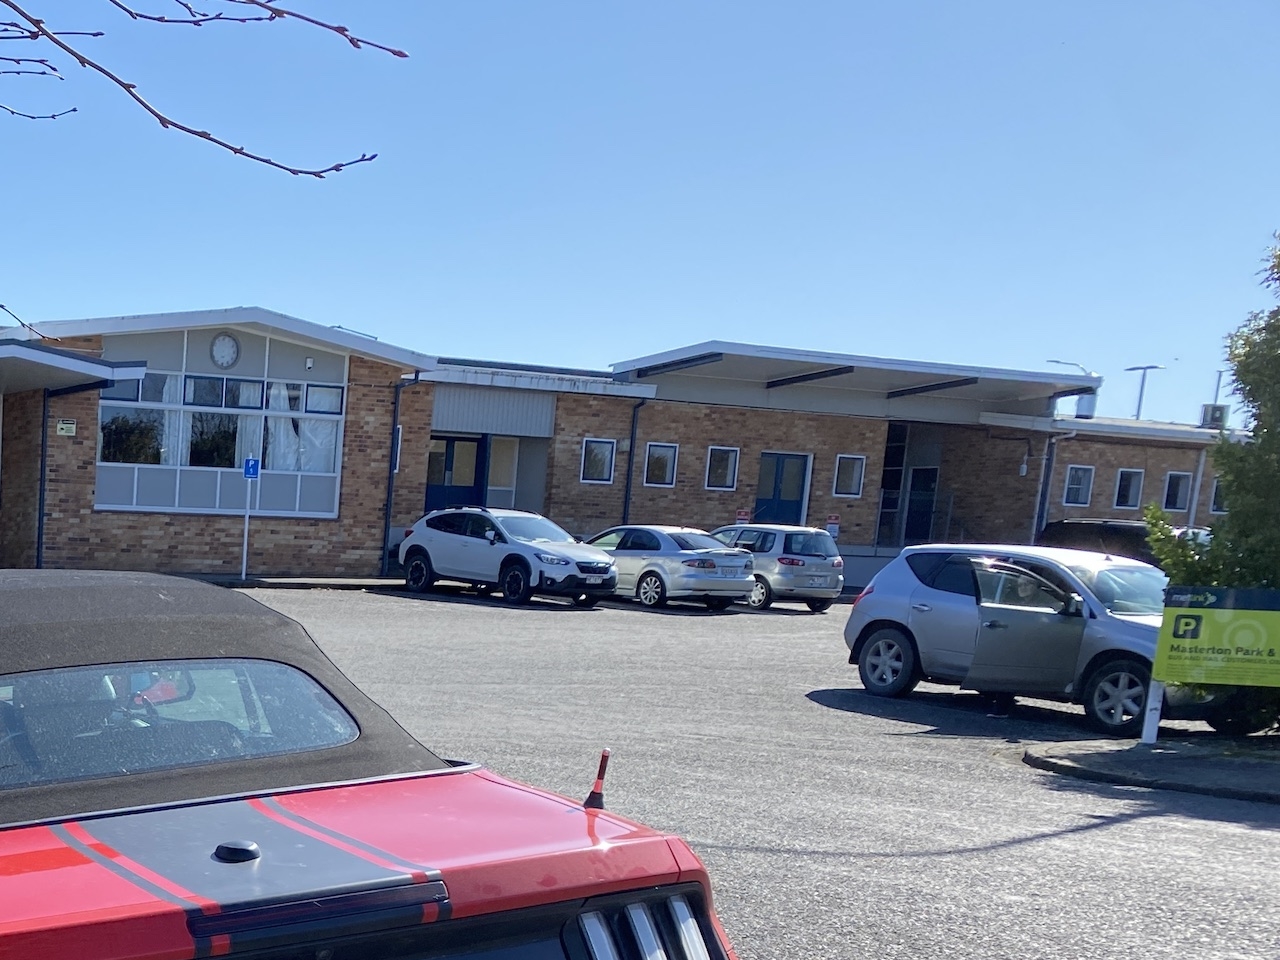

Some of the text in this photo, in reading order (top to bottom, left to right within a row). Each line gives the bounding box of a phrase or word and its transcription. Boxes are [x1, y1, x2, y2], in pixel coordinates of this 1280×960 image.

[1178, 618, 1196, 634] P
[1170, 644, 1276, 657] Masterton Park &
